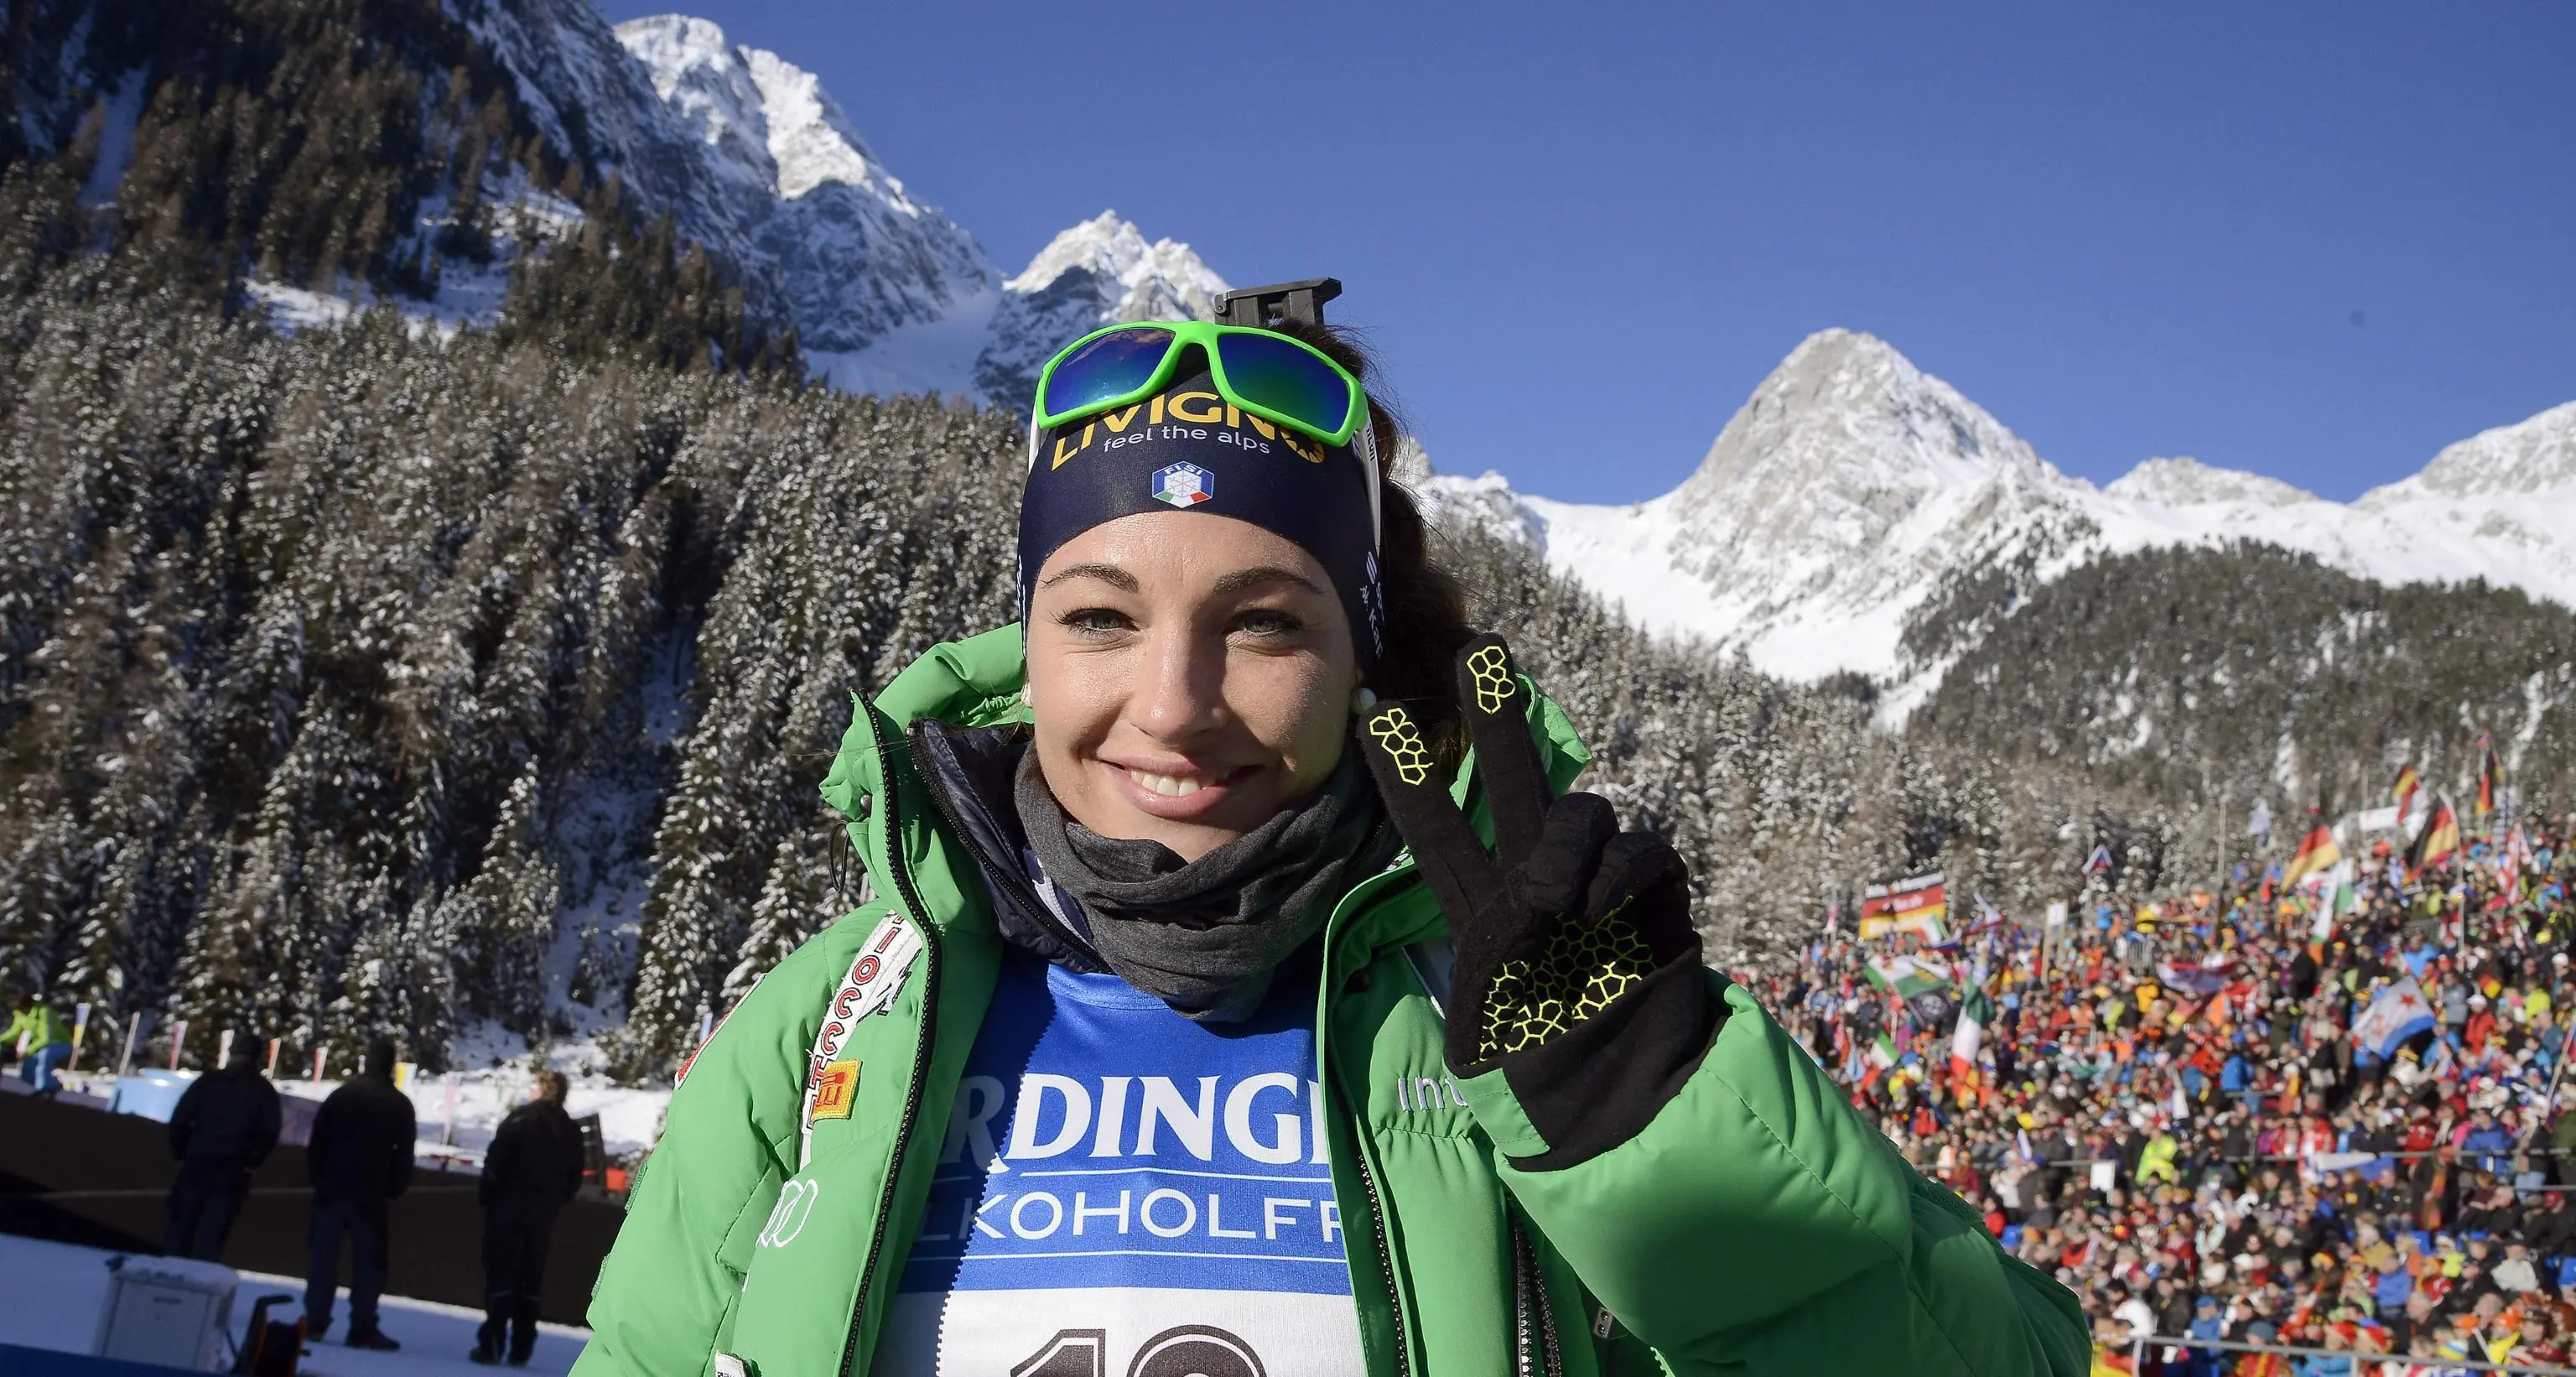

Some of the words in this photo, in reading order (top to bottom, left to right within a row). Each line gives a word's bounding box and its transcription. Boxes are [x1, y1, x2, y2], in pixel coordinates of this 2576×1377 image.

[1103, 427, 1153, 453] feel
[1161, 425, 1208, 440] the
[1218, 431, 1270, 454] alps
[1164, 465, 1202, 475] FISI
[806, 914, 905, 1130] IOCCH
